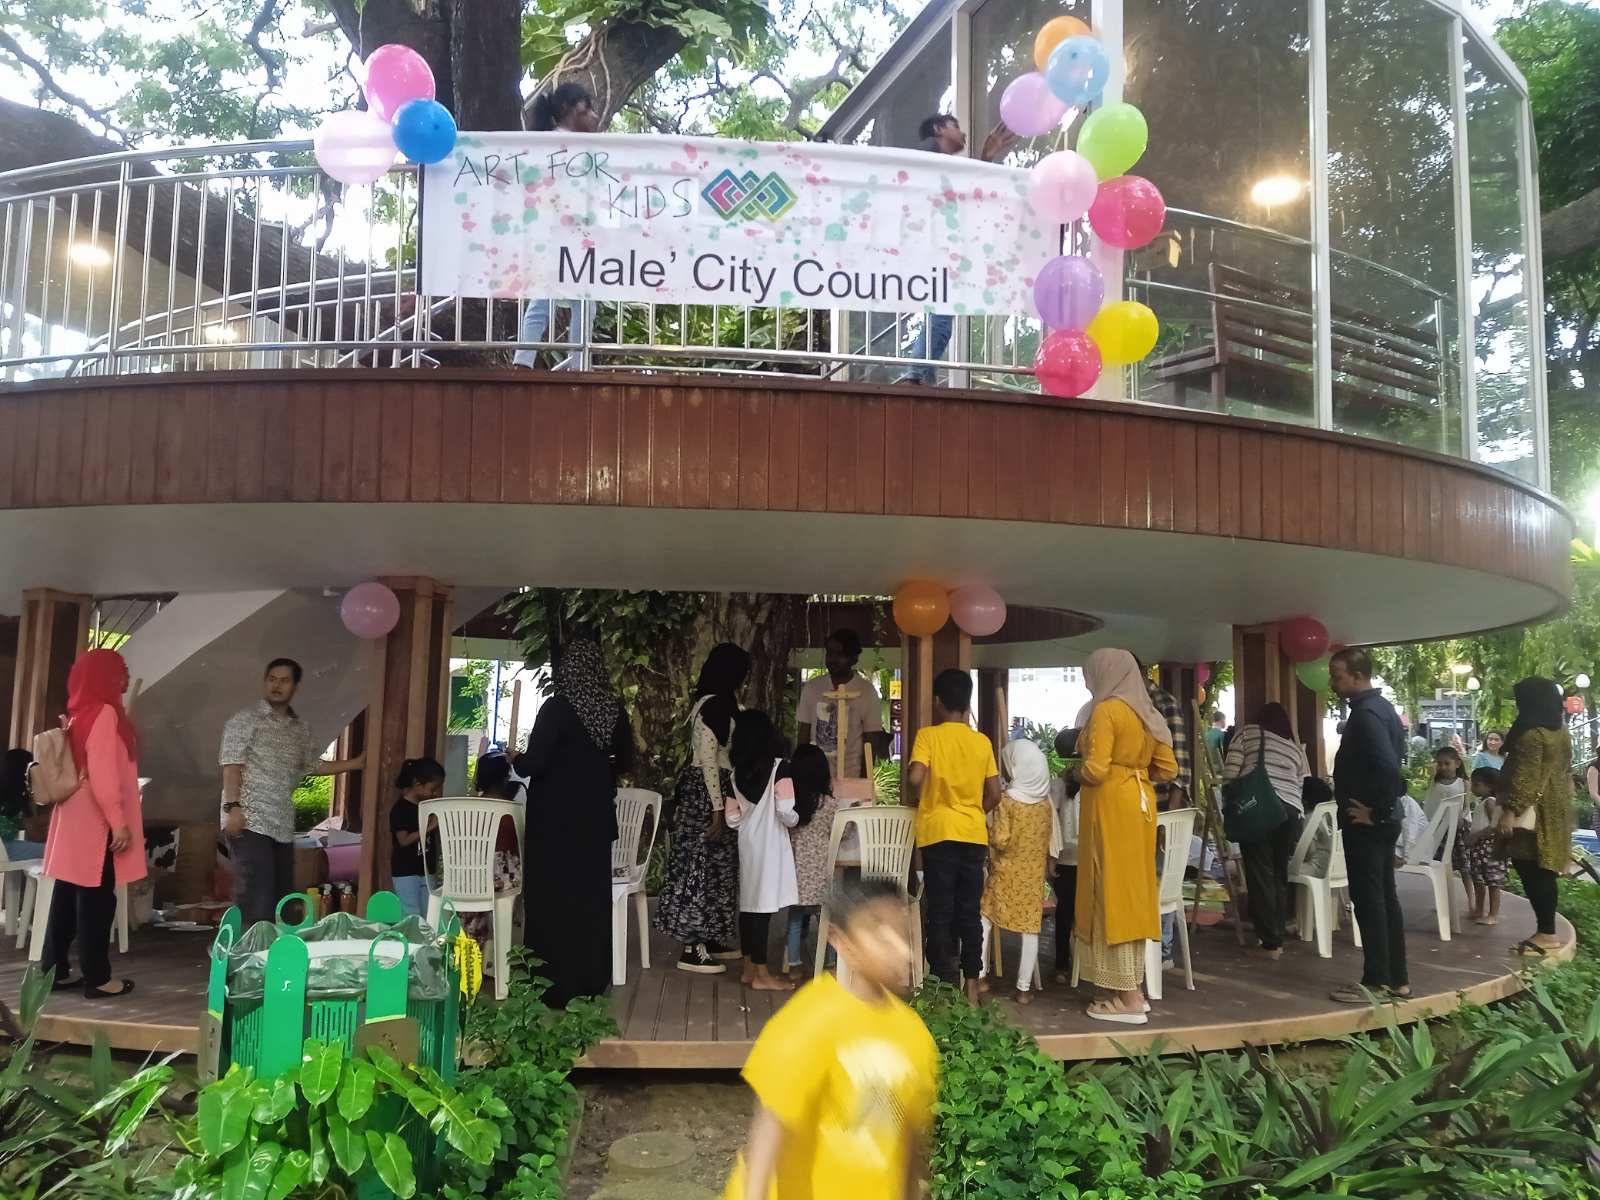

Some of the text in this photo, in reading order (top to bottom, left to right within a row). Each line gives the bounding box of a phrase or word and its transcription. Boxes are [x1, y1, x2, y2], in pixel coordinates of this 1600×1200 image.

[453, 149, 620, 188] ART FOR
[607, 178, 692, 219] KIDS
[693, 252, 777, 305] City
[793, 259, 949, 304] Council
